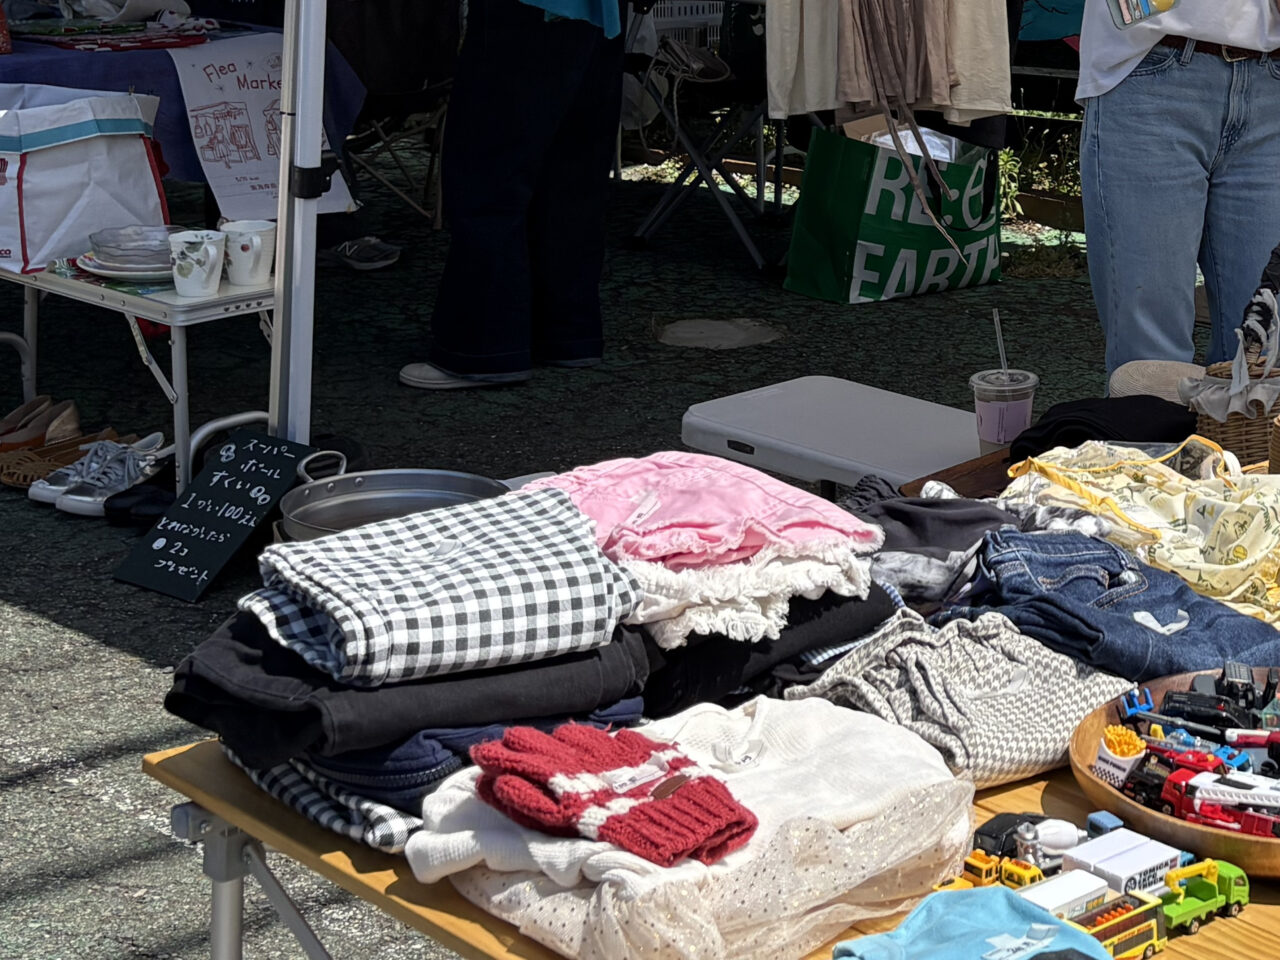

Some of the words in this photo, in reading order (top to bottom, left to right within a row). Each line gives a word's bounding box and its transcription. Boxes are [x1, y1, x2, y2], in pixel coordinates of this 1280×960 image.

[203, 62, 237, 83] Flea
[236, 73, 283, 91] Marke
[243, 439, 296, 459] スーパー
[240, 459, 281, 479] ボール
